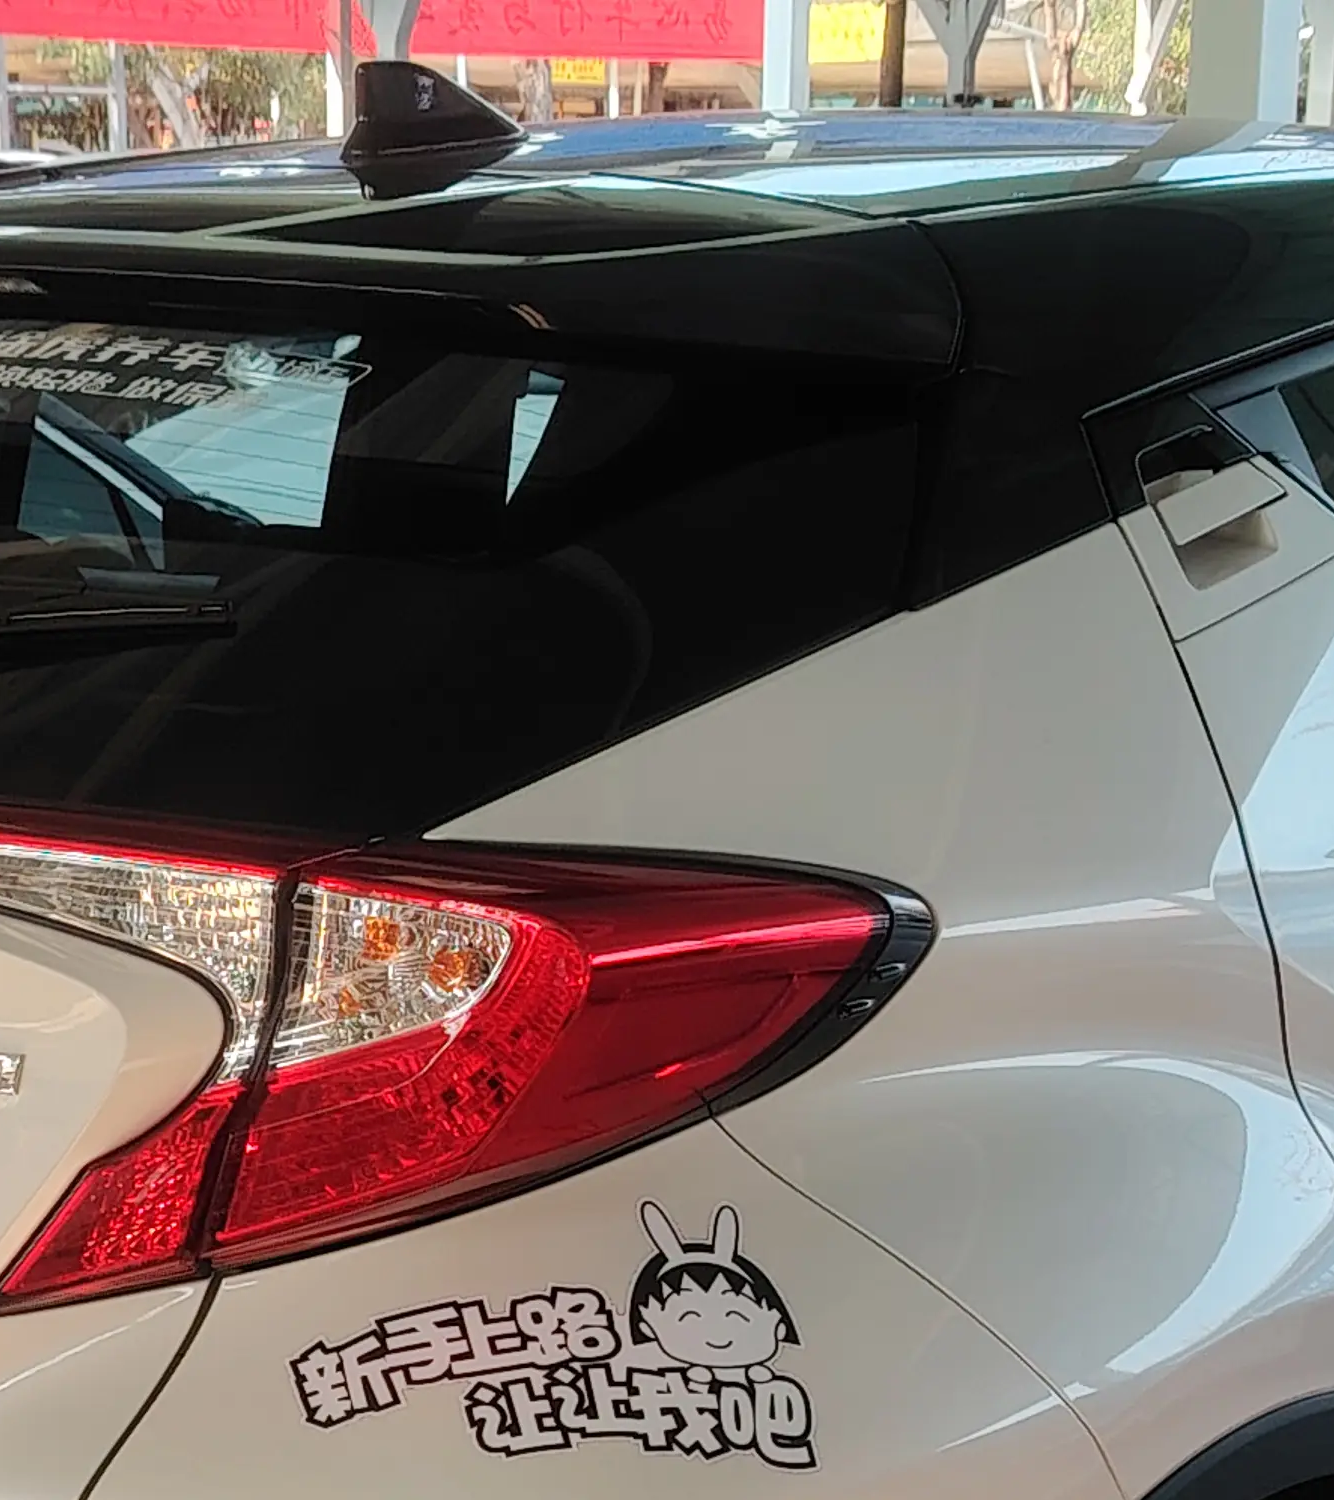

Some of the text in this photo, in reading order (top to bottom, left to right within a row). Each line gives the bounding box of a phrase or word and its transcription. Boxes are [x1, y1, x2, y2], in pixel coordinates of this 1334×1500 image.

[289, 1286, 623, 1428] 新手上路
[463, 1367, 818, 1470] 让让我吧
